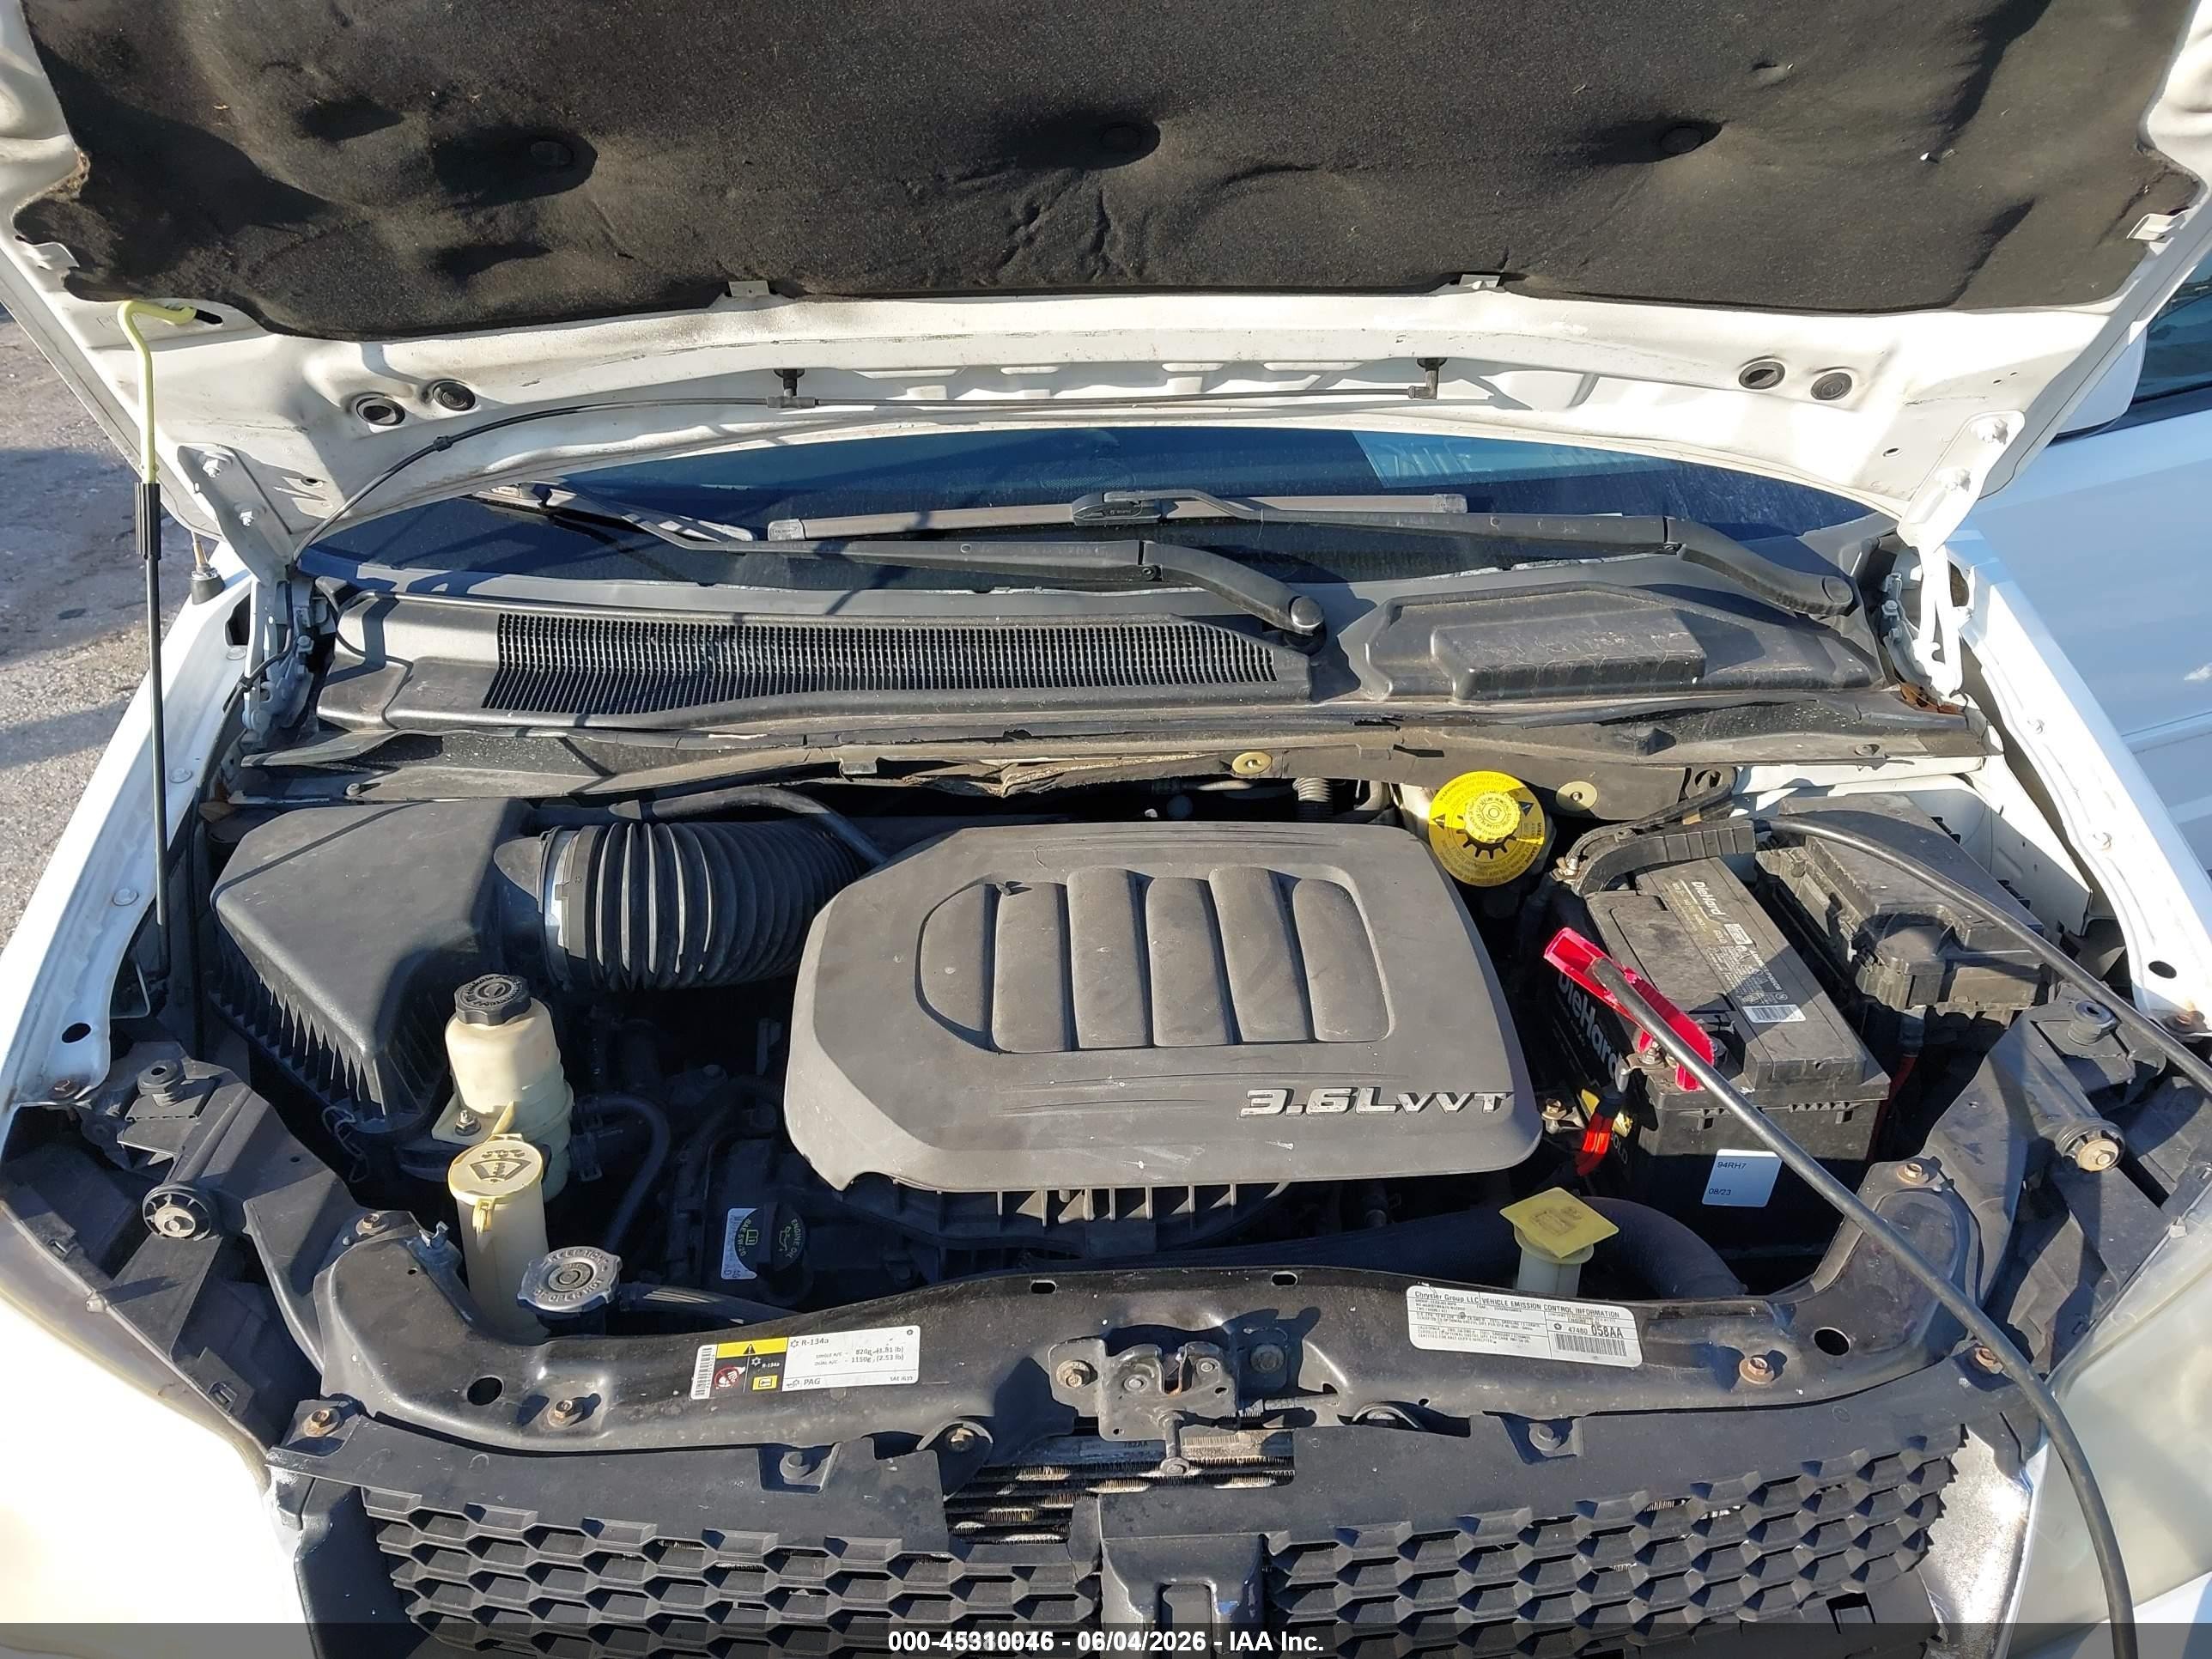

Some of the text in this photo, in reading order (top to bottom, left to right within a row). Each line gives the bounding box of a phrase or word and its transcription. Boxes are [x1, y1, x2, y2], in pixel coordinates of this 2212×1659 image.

[1691, 881, 1727, 915] DieHard
[1717, 1161, 1747, 1170] 94RH7
[1708, 1188, 1731, 1196] 08/23
[739, 1218, 752, 1233] SAE
[785, 1218, 802, 1259] ENGINE OIL
[1414, 1291, 1442, 1301] Chrysler
[1444, 1293, 1465, 1304] Group
[1480, 1297, 1508, 1307] VEHICLE
[1510, 1300, 1542, 1310] EMISSION
[1543, 1304, 1573, 1314] CONTROL
[1575, 1307, 1620, 1318] INFORMATION
[1591, 1324, 1624, 1339] 058AA
[800, 1338, 830, 1346] R-134a
